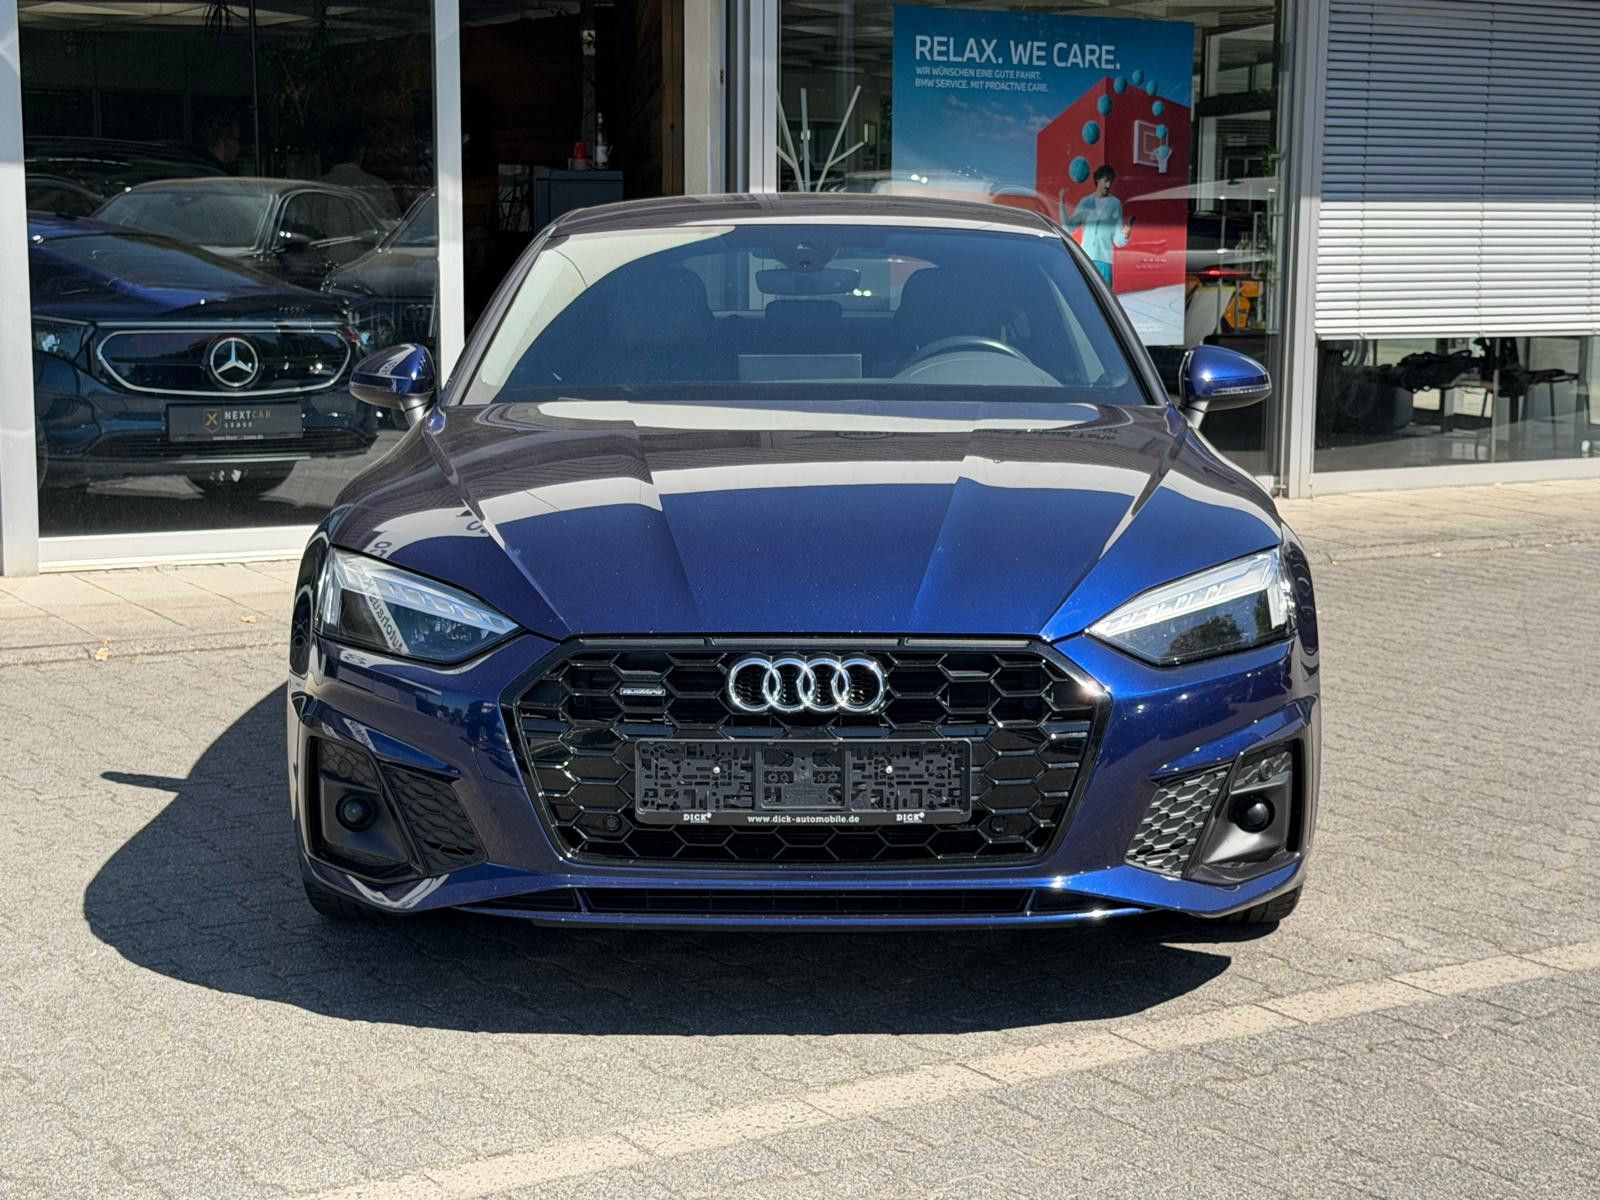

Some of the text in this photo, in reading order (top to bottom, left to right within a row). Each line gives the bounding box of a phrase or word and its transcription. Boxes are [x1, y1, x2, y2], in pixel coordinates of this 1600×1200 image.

[915, 35, 1121, 70] RELAX. WE CARE.
[915, 66, 1042, 80] WIR WÜNSCHEN EINE GUTE FAHRT.
[915, 78, 1049, 92] BMW SERVICE. MIT PROACTIVE CARE.
[683, 813, 708, 821] DICK
[747, 815, 860, 823] www.dick-automobile.de
[896, 813, 921, 821] DICK
